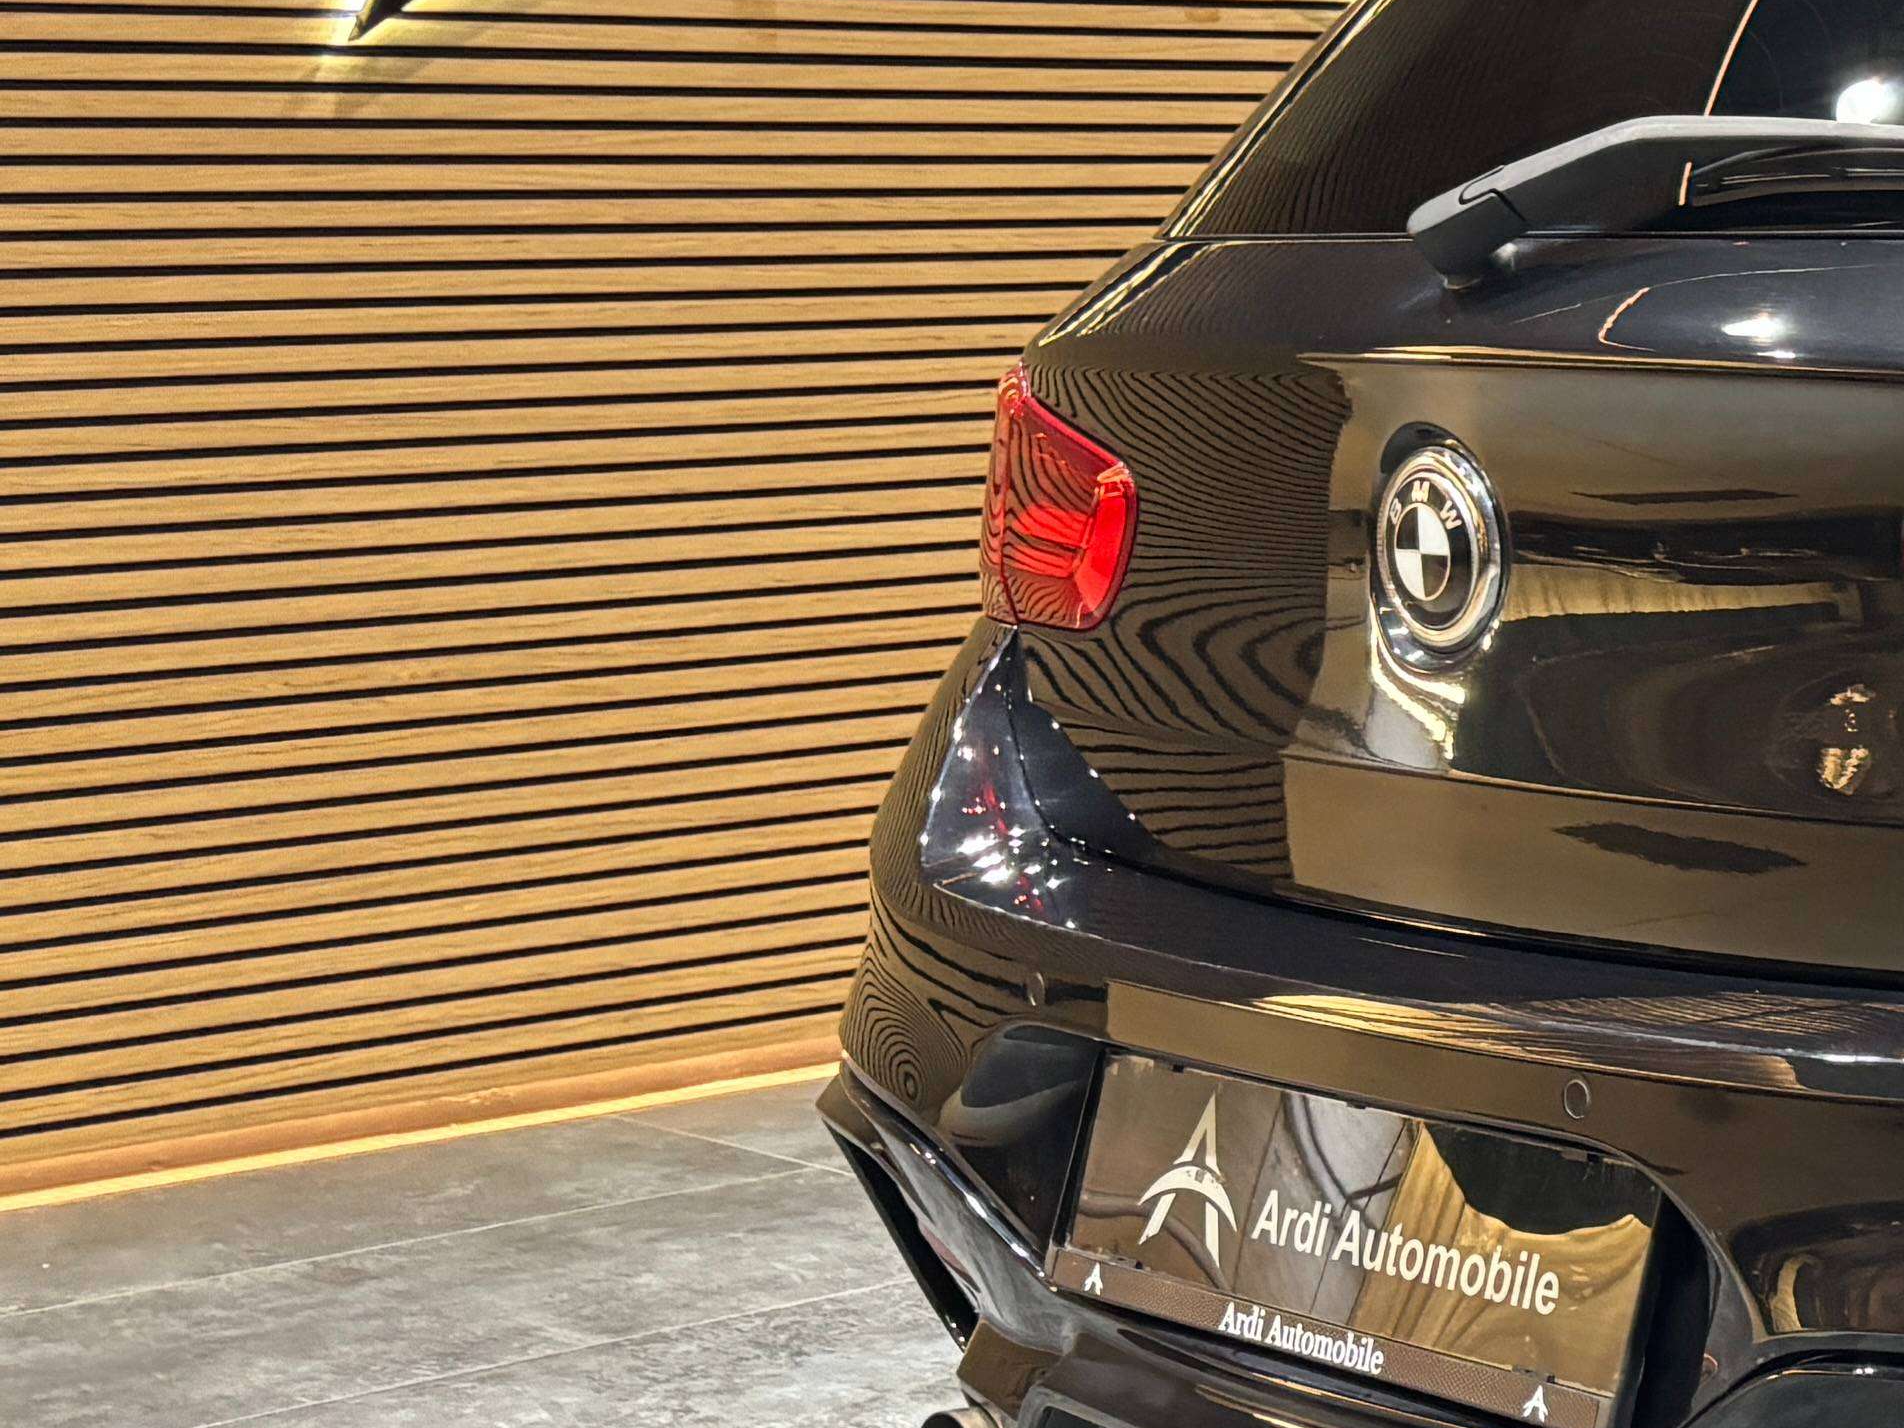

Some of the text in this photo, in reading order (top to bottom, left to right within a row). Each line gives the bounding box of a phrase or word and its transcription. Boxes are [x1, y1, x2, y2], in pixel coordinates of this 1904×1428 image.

[1388, 479, 1464, 530] BMW
[1251, 1188, 1561, 1316] Ardi Automobile
[1218, 1302, 1385, 1375] Ardi Automobile
